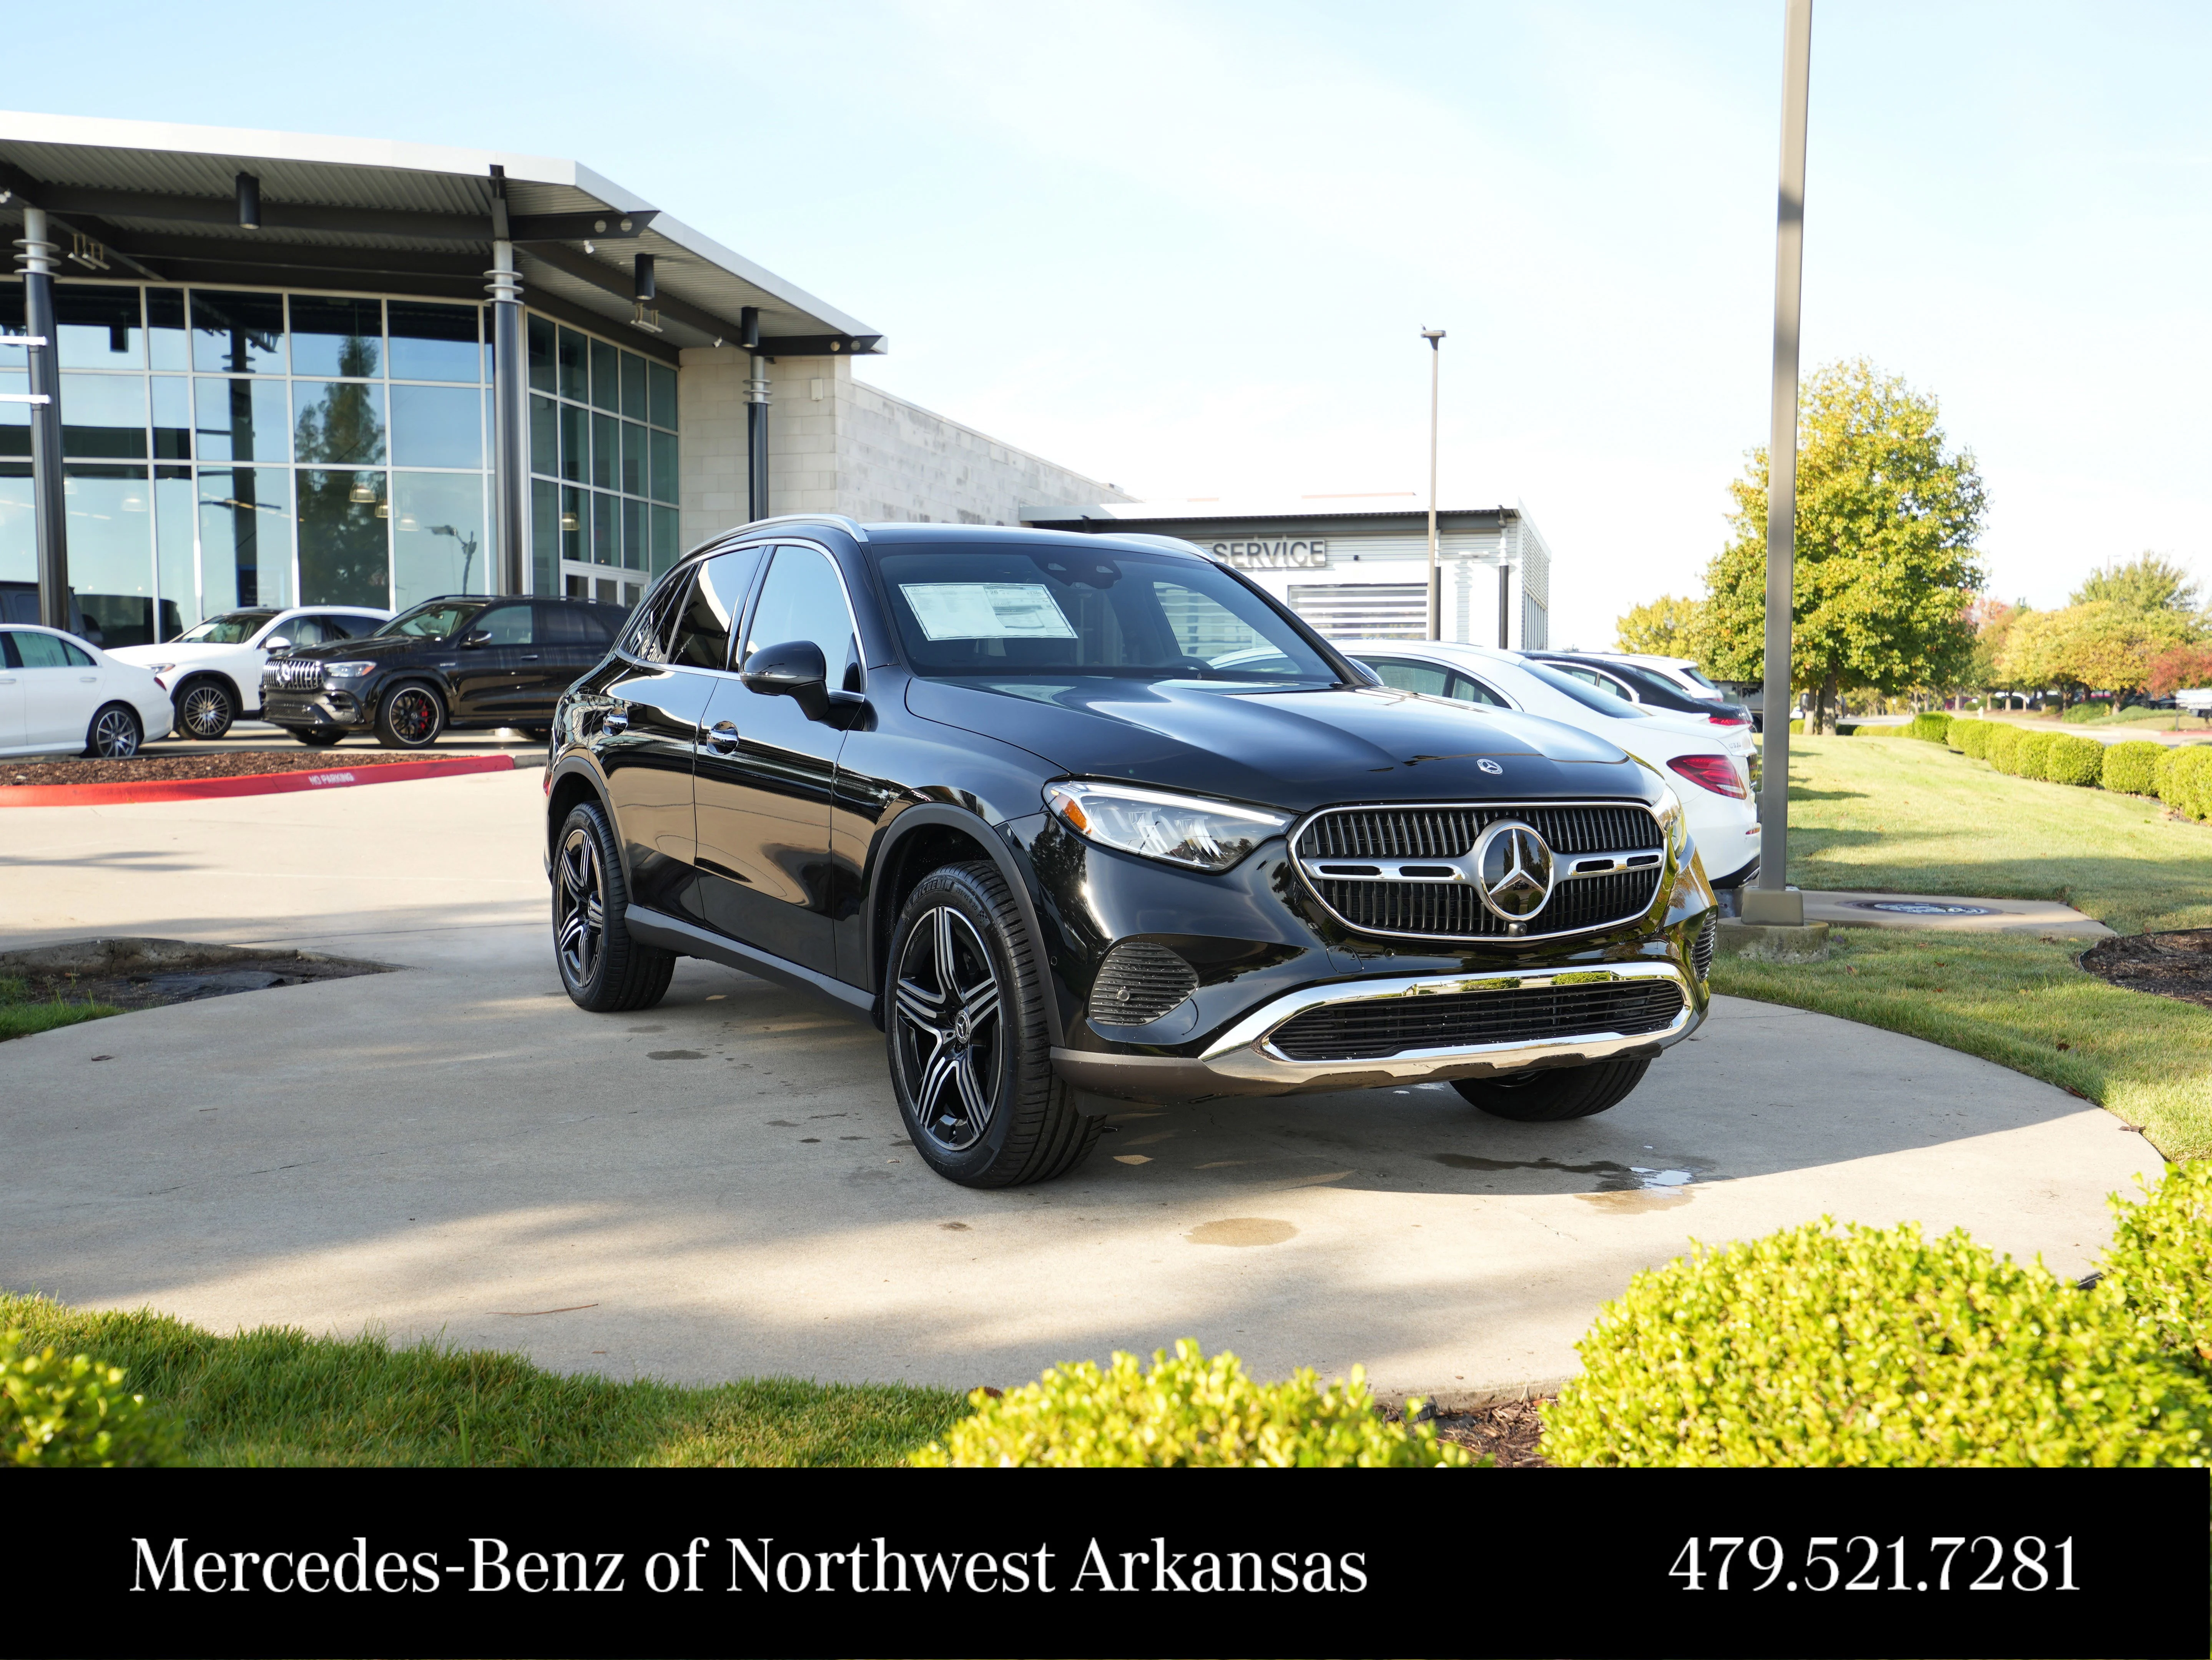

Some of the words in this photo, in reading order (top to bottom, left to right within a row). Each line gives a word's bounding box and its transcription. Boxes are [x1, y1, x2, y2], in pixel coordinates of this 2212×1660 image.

[1212, 541, 1324, 567] SERVICE
[308, 775, 322, 785] NO
[321, 772, 355, 785] PARKING
[912, 879, 952, 904] MICHELIN
[956, 888, 969, 900] 255/45
